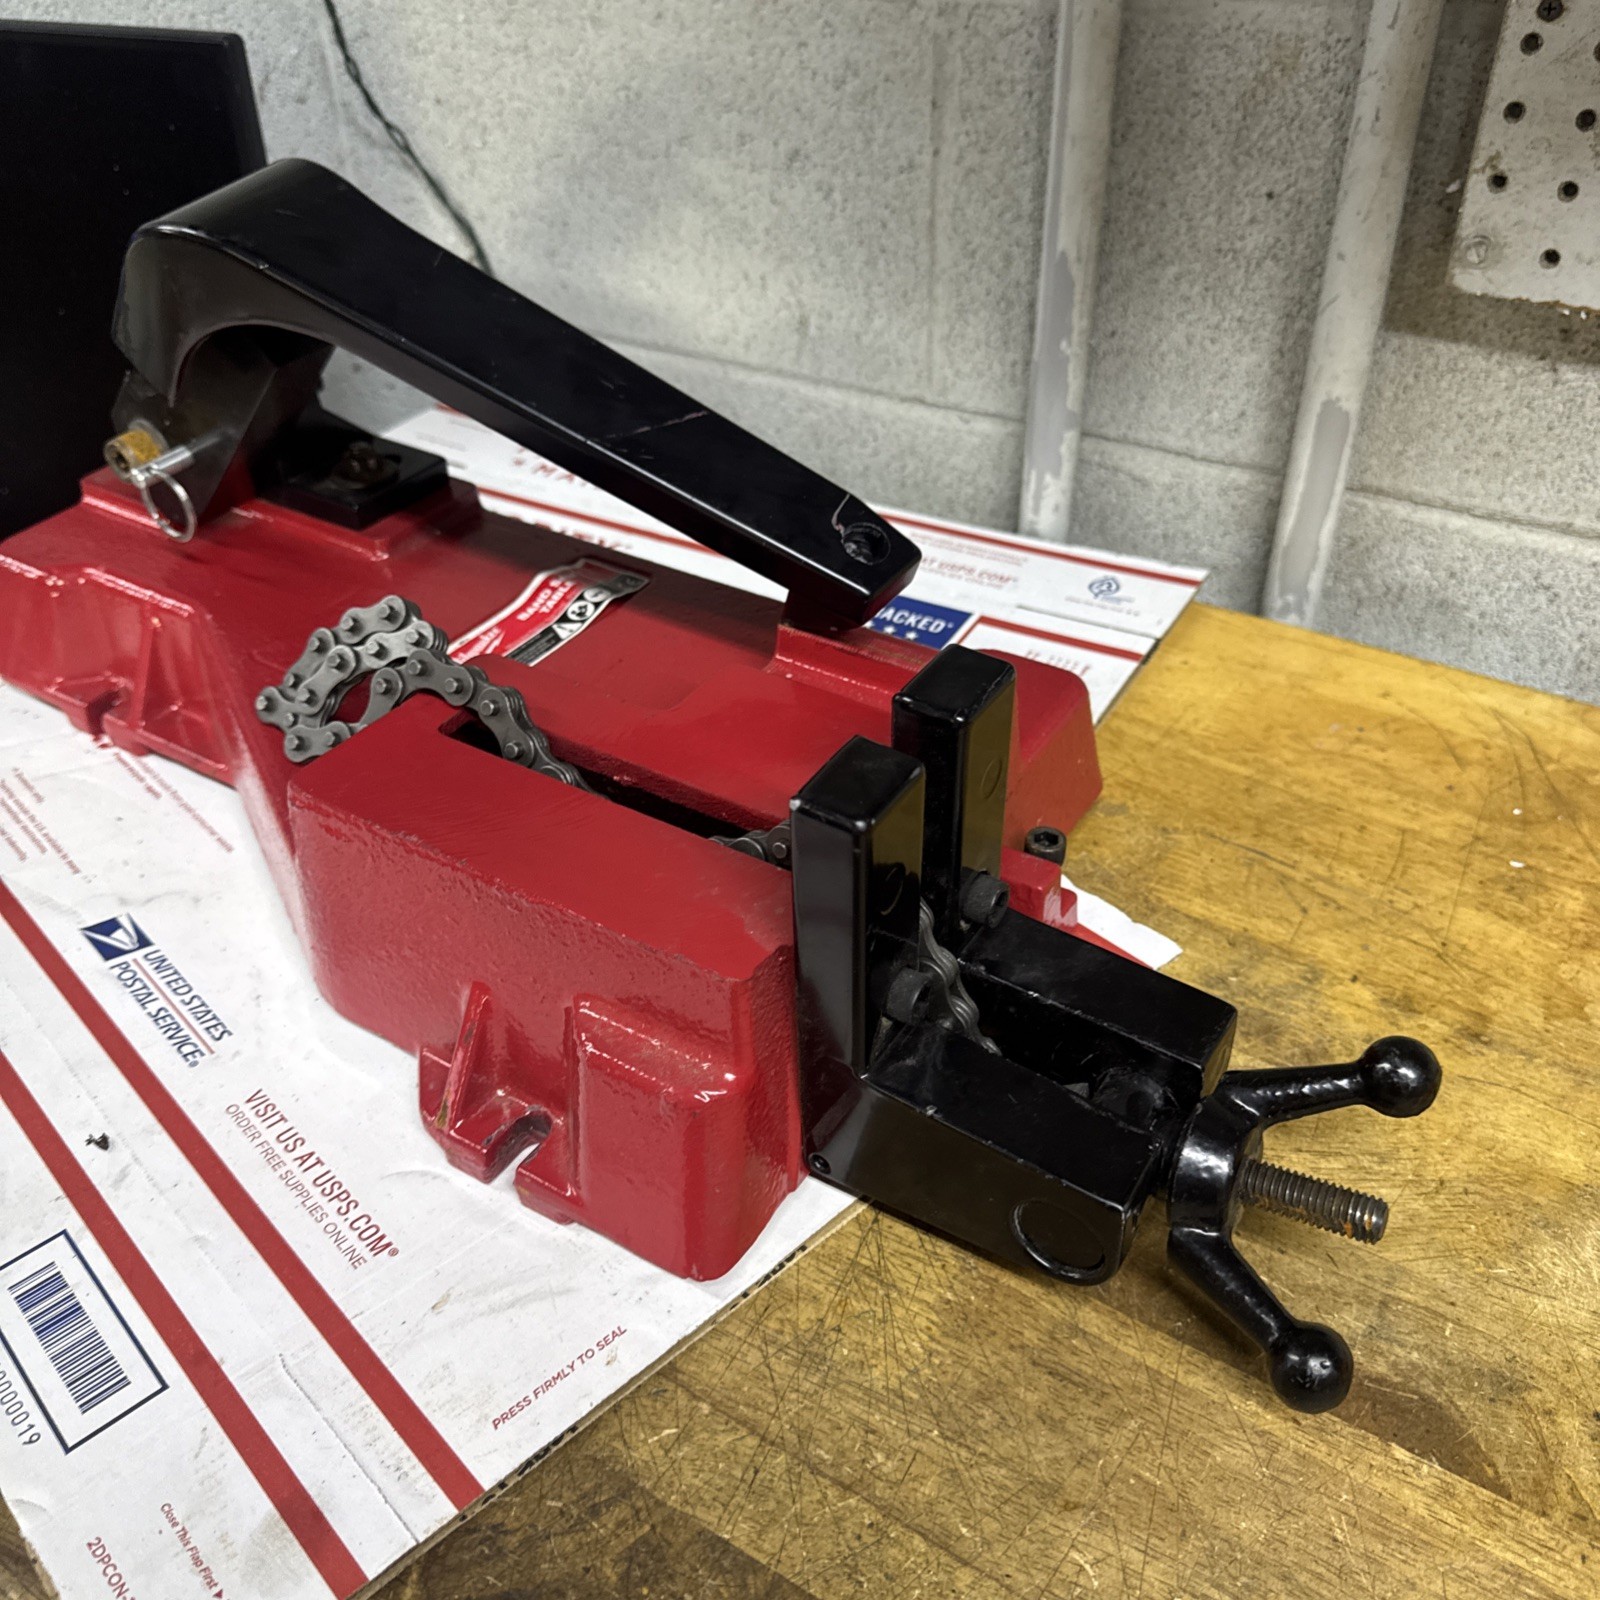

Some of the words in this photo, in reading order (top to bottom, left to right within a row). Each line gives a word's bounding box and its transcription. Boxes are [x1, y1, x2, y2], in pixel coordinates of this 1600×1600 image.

[516, 588, 552, 621] BAND
[109, 961, 159, 1011] POSTAL
[143, 949, 194, 997] UNITED
[181, 994, 233, 1042] STATES
[225, 1103, 262, 1143] ORDER
[254, 1139, 287, 1172] FREE
[279, 1167, 330, 1224] SUPPLIES
[322, 1221, 368, 1271] ONLINE
[245, 1088, 289, 1130] VISIT
[275, 1126, 306, 1154] US
[292, 1151, 325, 1174] AT
[311, 1169, 400, 1258] USPS.COM®
[491, 1395, 532, 1431] PRESS
[532, 1360, 576, 1400] FIRMLY
[576, 1348, 596, 1365] TO
[595, 1325, 628, 1352] SEAL
[160, 1502, 180, 1528] Close
[174, 1525, 192, 1548] This
[186, 1545, 204, 1568] Flap
[198, 1565, 219, 1590] First
